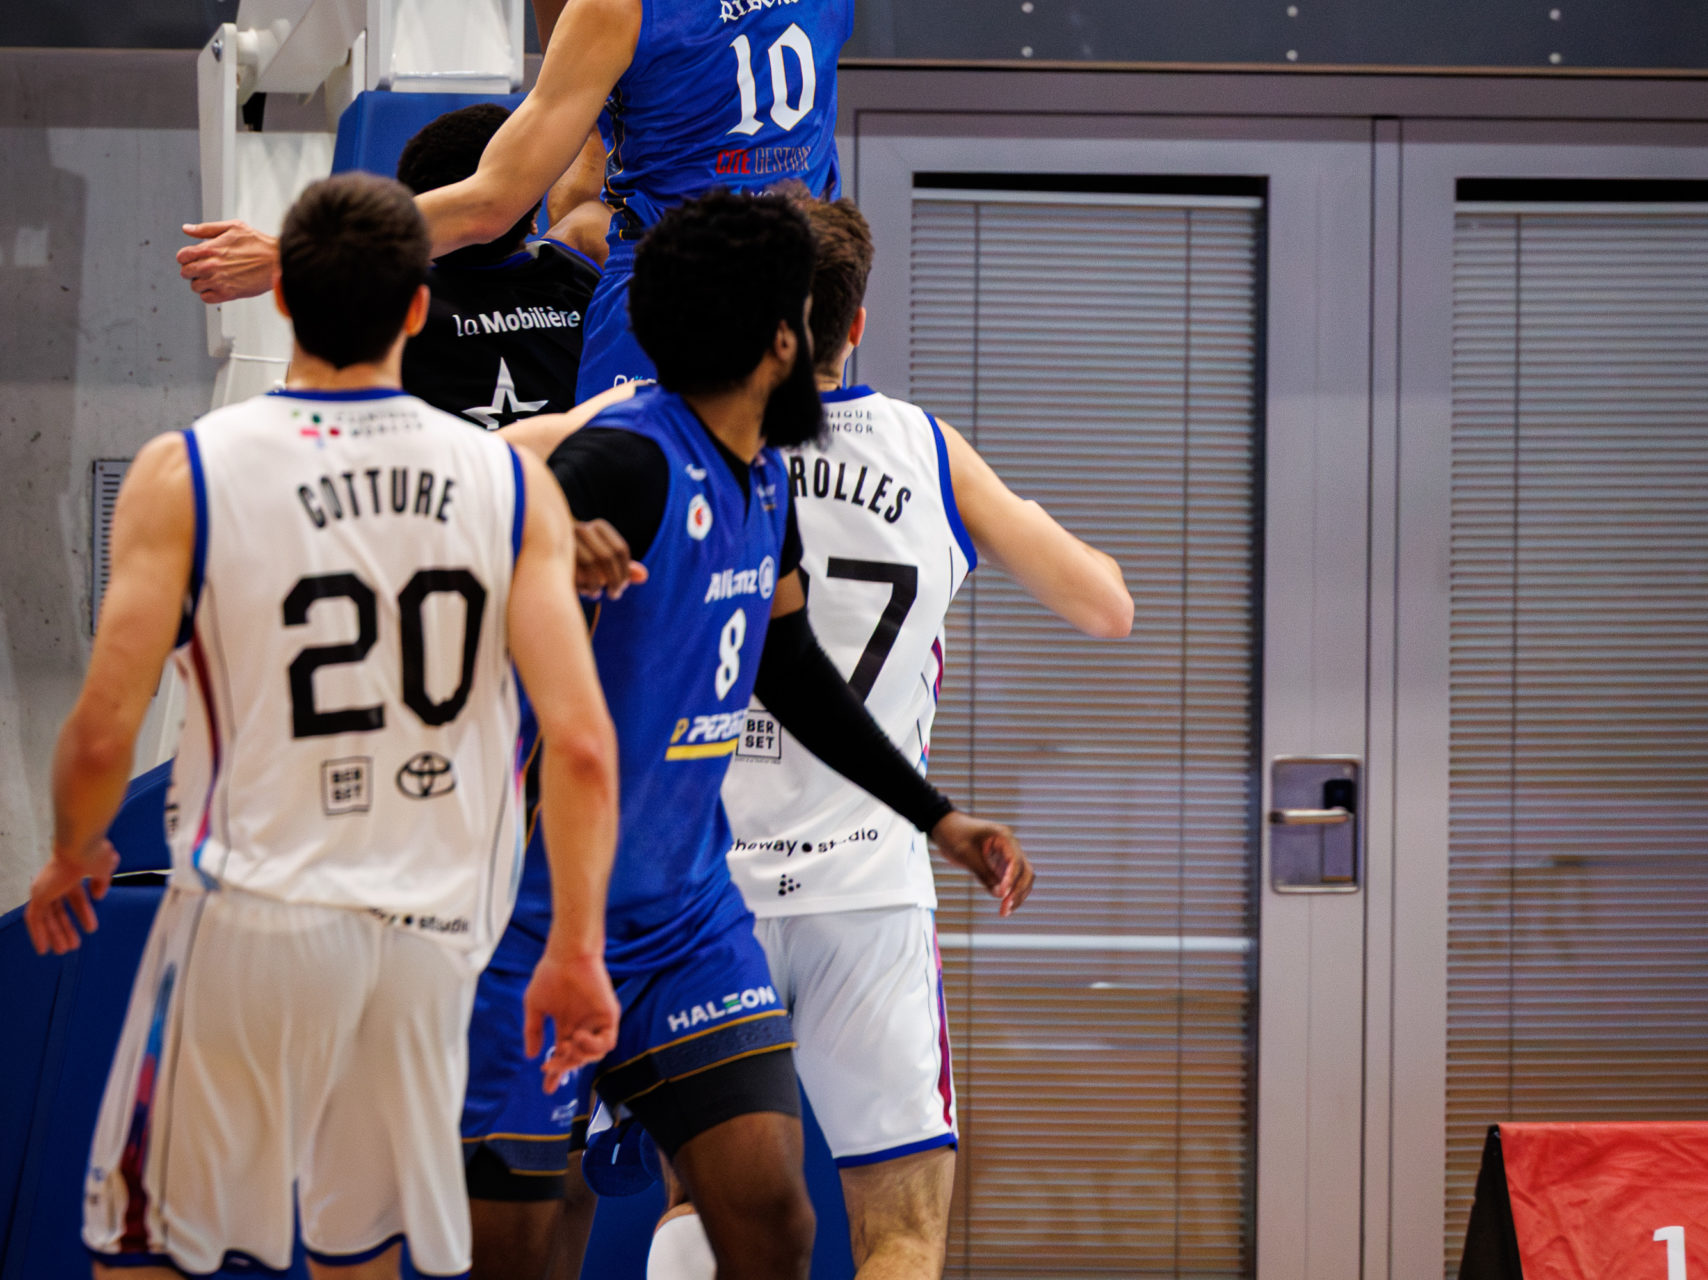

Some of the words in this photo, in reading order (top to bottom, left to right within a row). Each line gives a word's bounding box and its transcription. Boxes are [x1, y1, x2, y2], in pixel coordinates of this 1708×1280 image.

[725, 22, 816, 136] 10
[453, 314, 479, 336] la
[478, 305, 581, 335] Mobilière
[298, 468, 455, 529] COTTURE
[789, 455, 912, 524] ROLLES
[281, 567, 488, 740] 20
[715, 607, 747, 702] 8
[826, 556, 918, 706] 7
[745, 735, 775, 750] SET
[746, 719, 775, 735] BER
[731, 837, 798, 857] heway
[818, 827, 879, 854] stdio
[667, 985, 777, 1033] HALEON
[1652, 1225, 1687, 1280] 1
